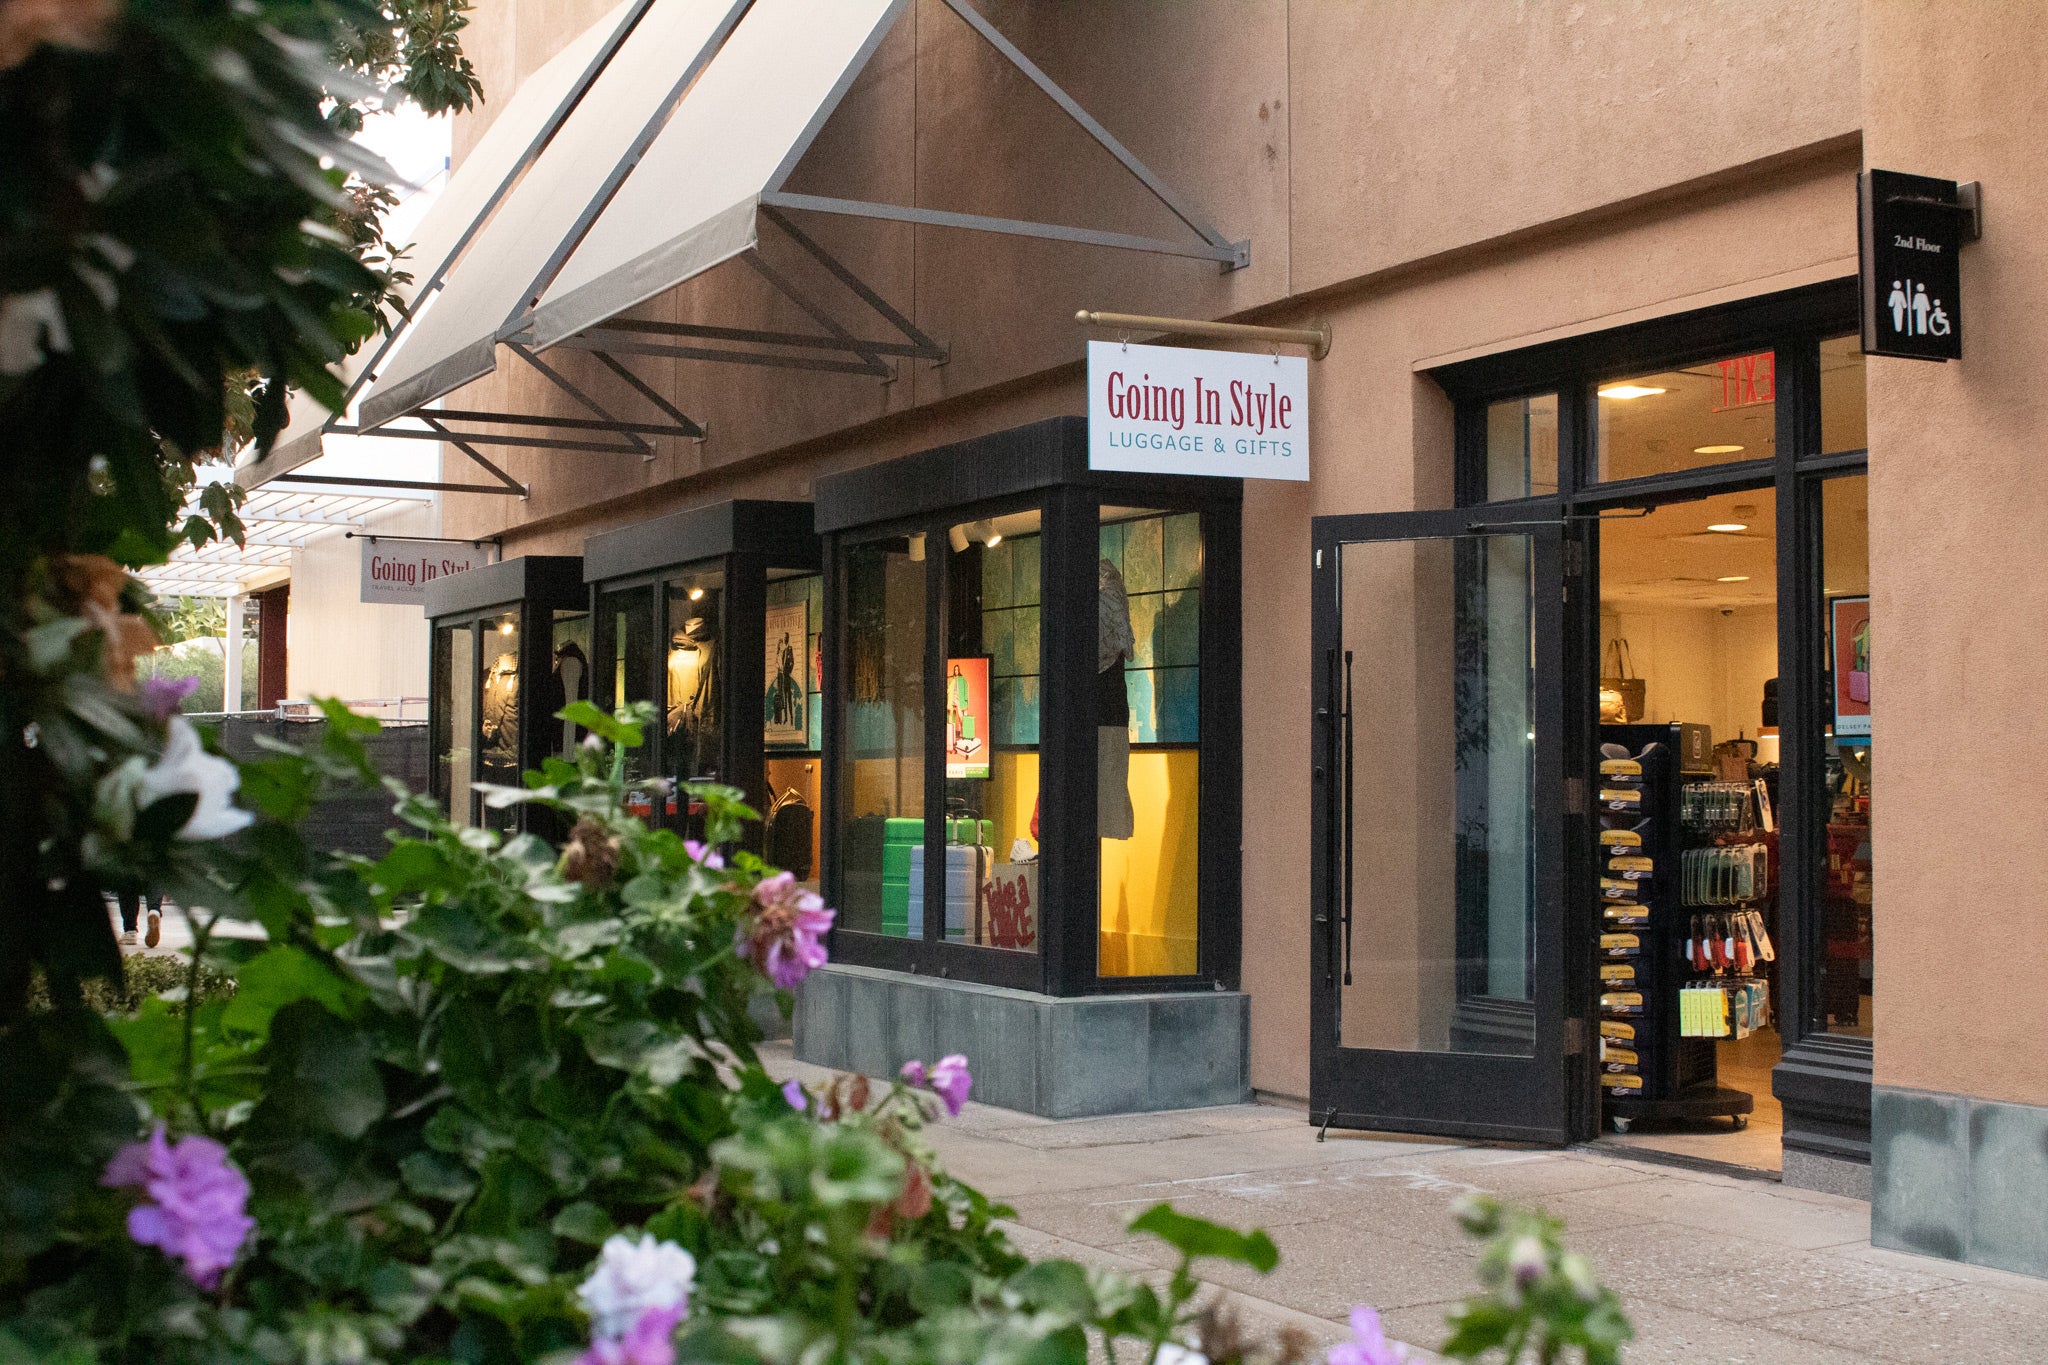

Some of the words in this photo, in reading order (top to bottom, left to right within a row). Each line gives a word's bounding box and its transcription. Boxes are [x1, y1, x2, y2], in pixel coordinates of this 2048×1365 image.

[1894, 234, 1913, 249] 2nd
[1915, 237, 1941, 253] Floor
[1107, 371, 1185, 431] Going
[1193, 376, 1222, 426] In
[1229, 379, 1292, 436] Style
[1109, 431, 1204, 452] LUGGAGE
[1213, 437, 1226, 454] &
[1235, 438, 1292, 457] GIFTS
[371, 555, 416, 586] Going
[421, 558, 437, 582] In
